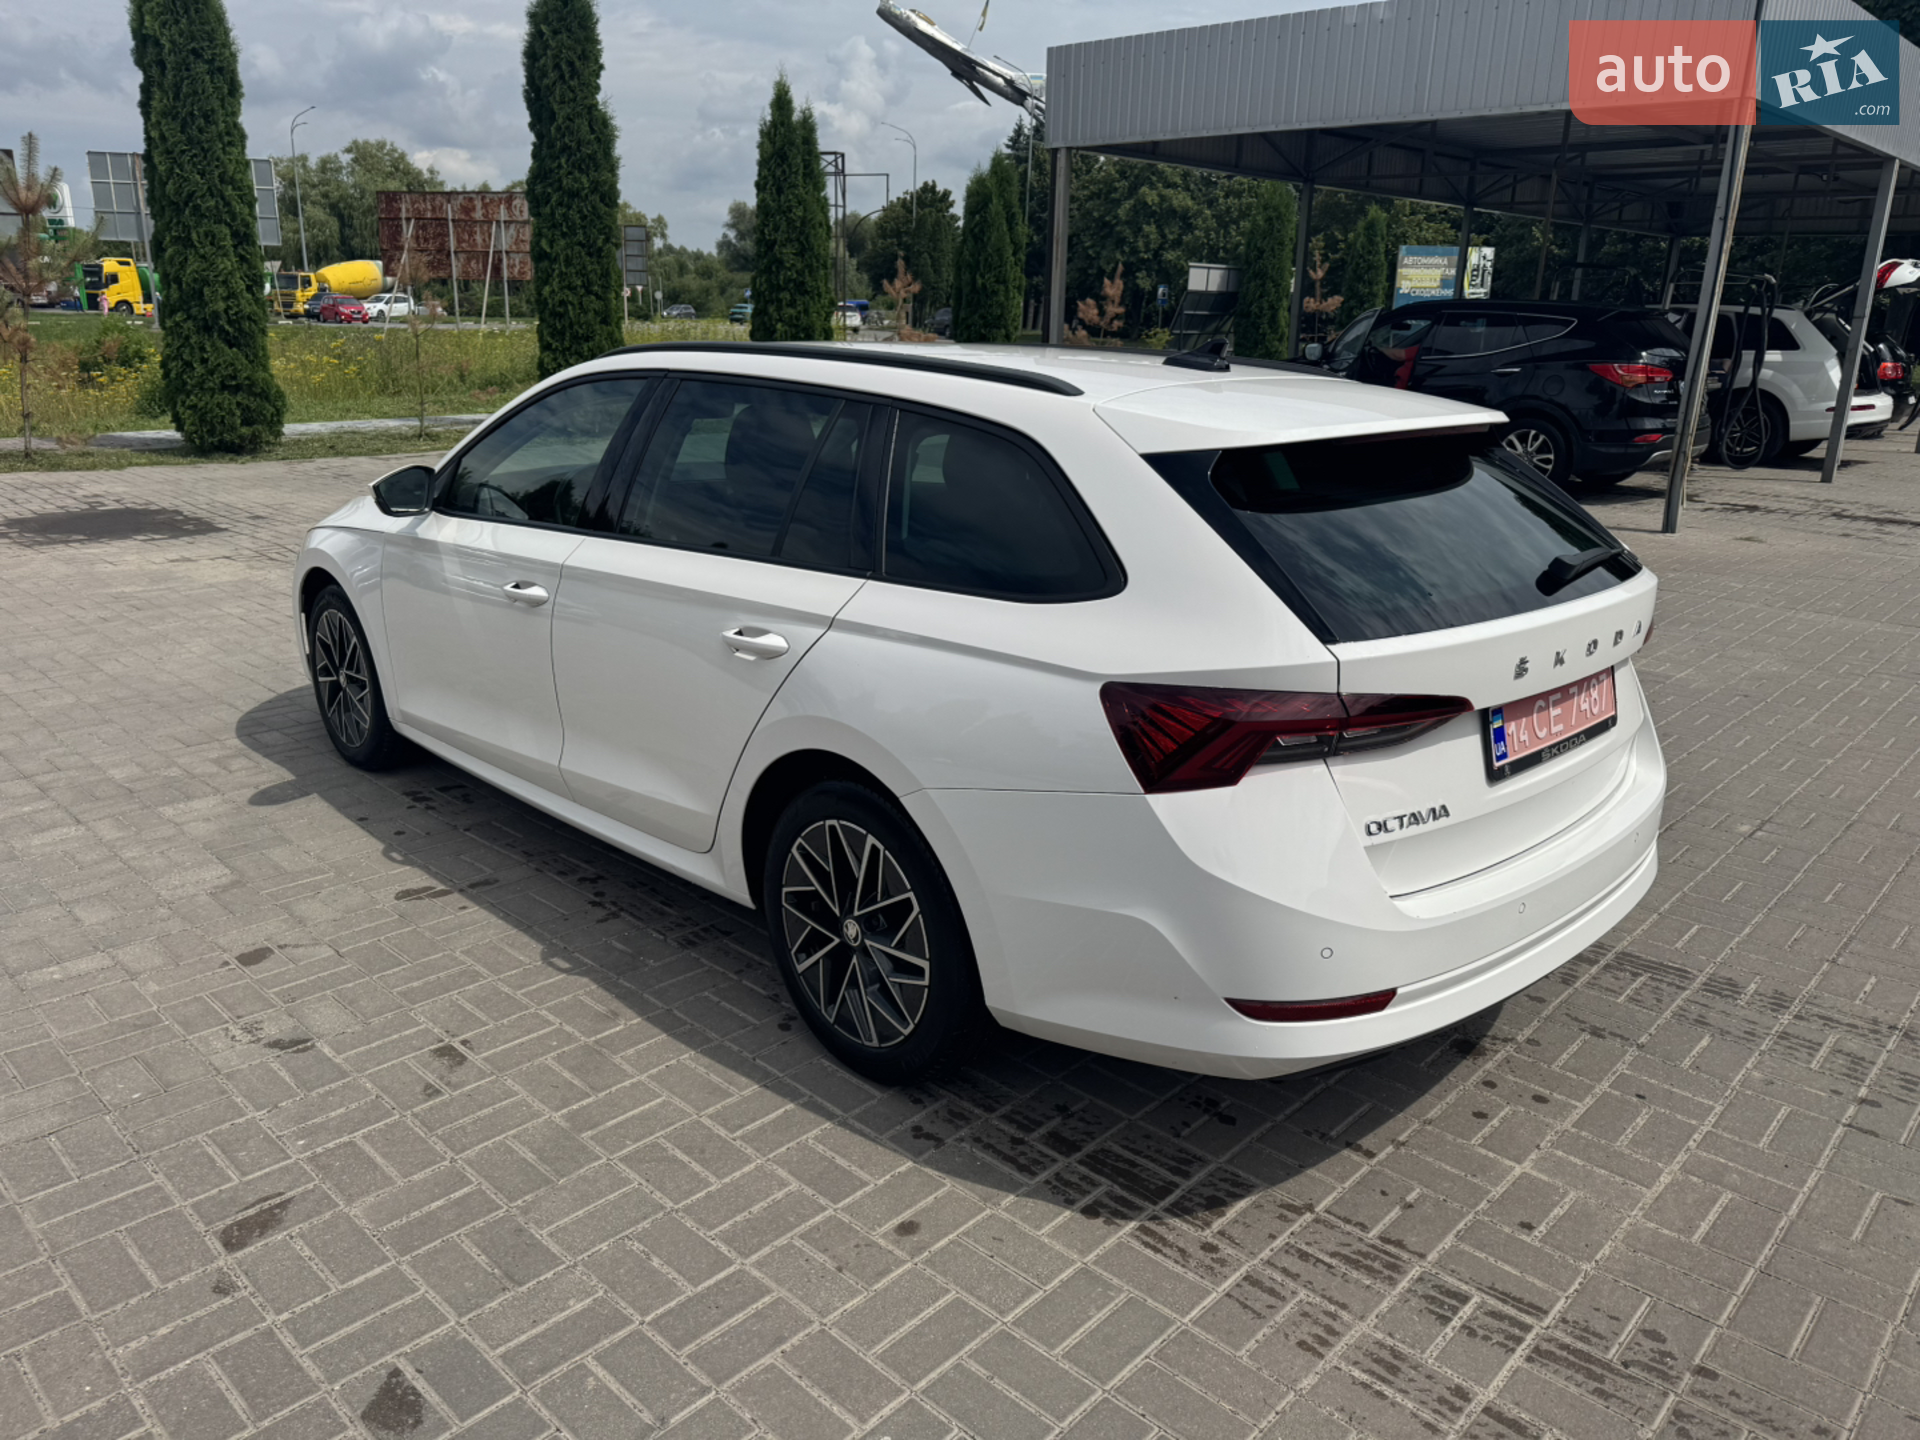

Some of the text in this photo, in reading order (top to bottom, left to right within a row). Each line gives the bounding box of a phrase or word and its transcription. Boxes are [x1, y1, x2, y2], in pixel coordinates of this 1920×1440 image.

[1402, 255, 1448, 265] АВТОМИЙКА
[1507, 673, 1608, 753] 14 CE 7487
[1495, 740, 1507, 756] UA
[1541, 733, 1587, 763] ŠKODA
[1364, 802, 1452, 838] OCTAVIA
